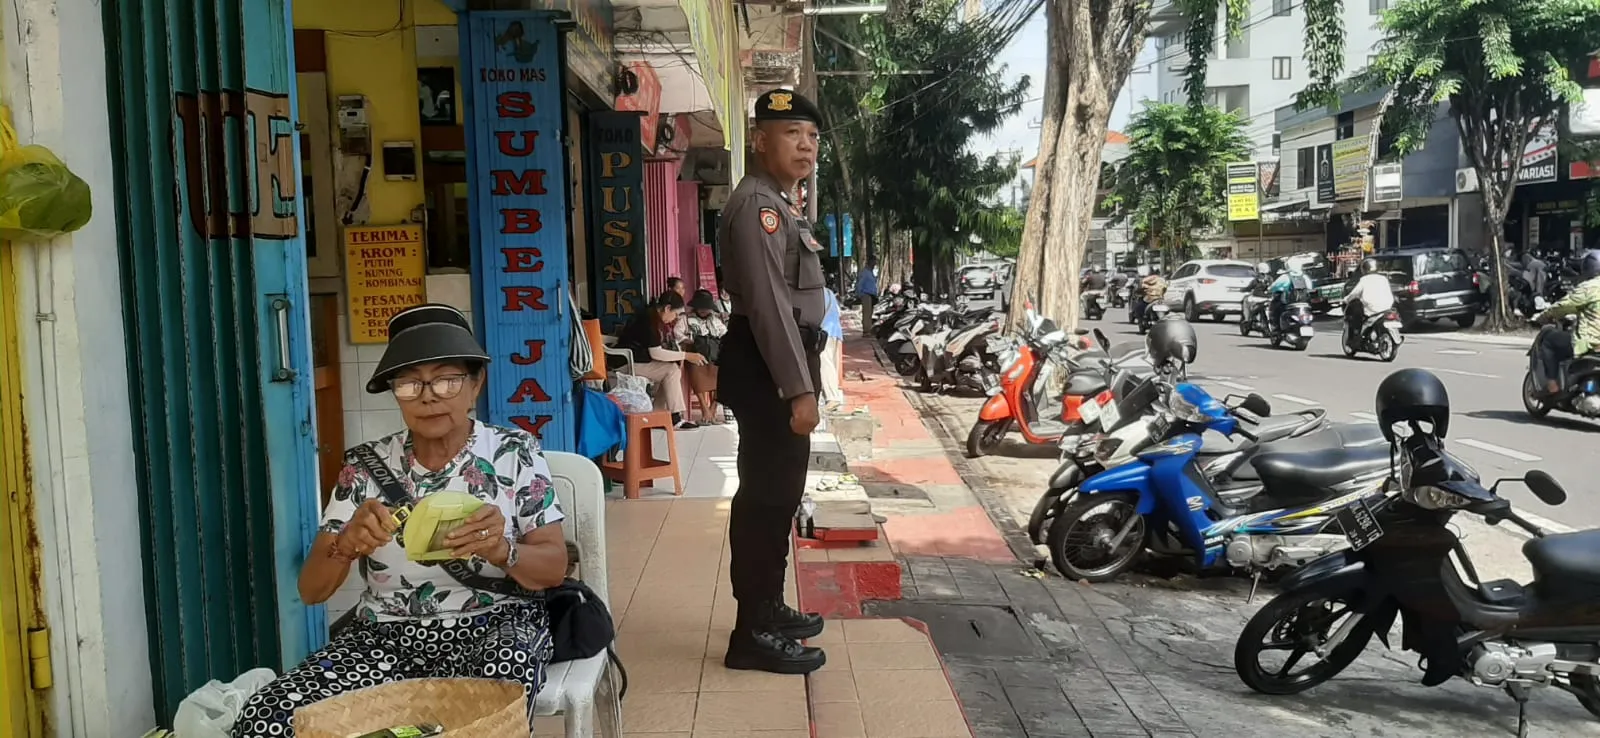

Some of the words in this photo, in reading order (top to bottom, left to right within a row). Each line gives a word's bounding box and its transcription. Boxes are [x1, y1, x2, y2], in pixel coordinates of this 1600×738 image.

[480, 68, 515, 83] TOKO
[520, 68, 547, 82] MAS
[1518, 164, 1554, 181] VARIASI
[490, 91, 549, 312] SUMBER
[350, 230, 409, 242] TERIMA
[361, 247, 406, 258] KROM
[364, 259, 394, 268] PUTIH
[365, 268, 403, 278] KUNING
[366, 278, 422, 288] KOMBINASI
[363, 295, 423, 306] PESANAN
